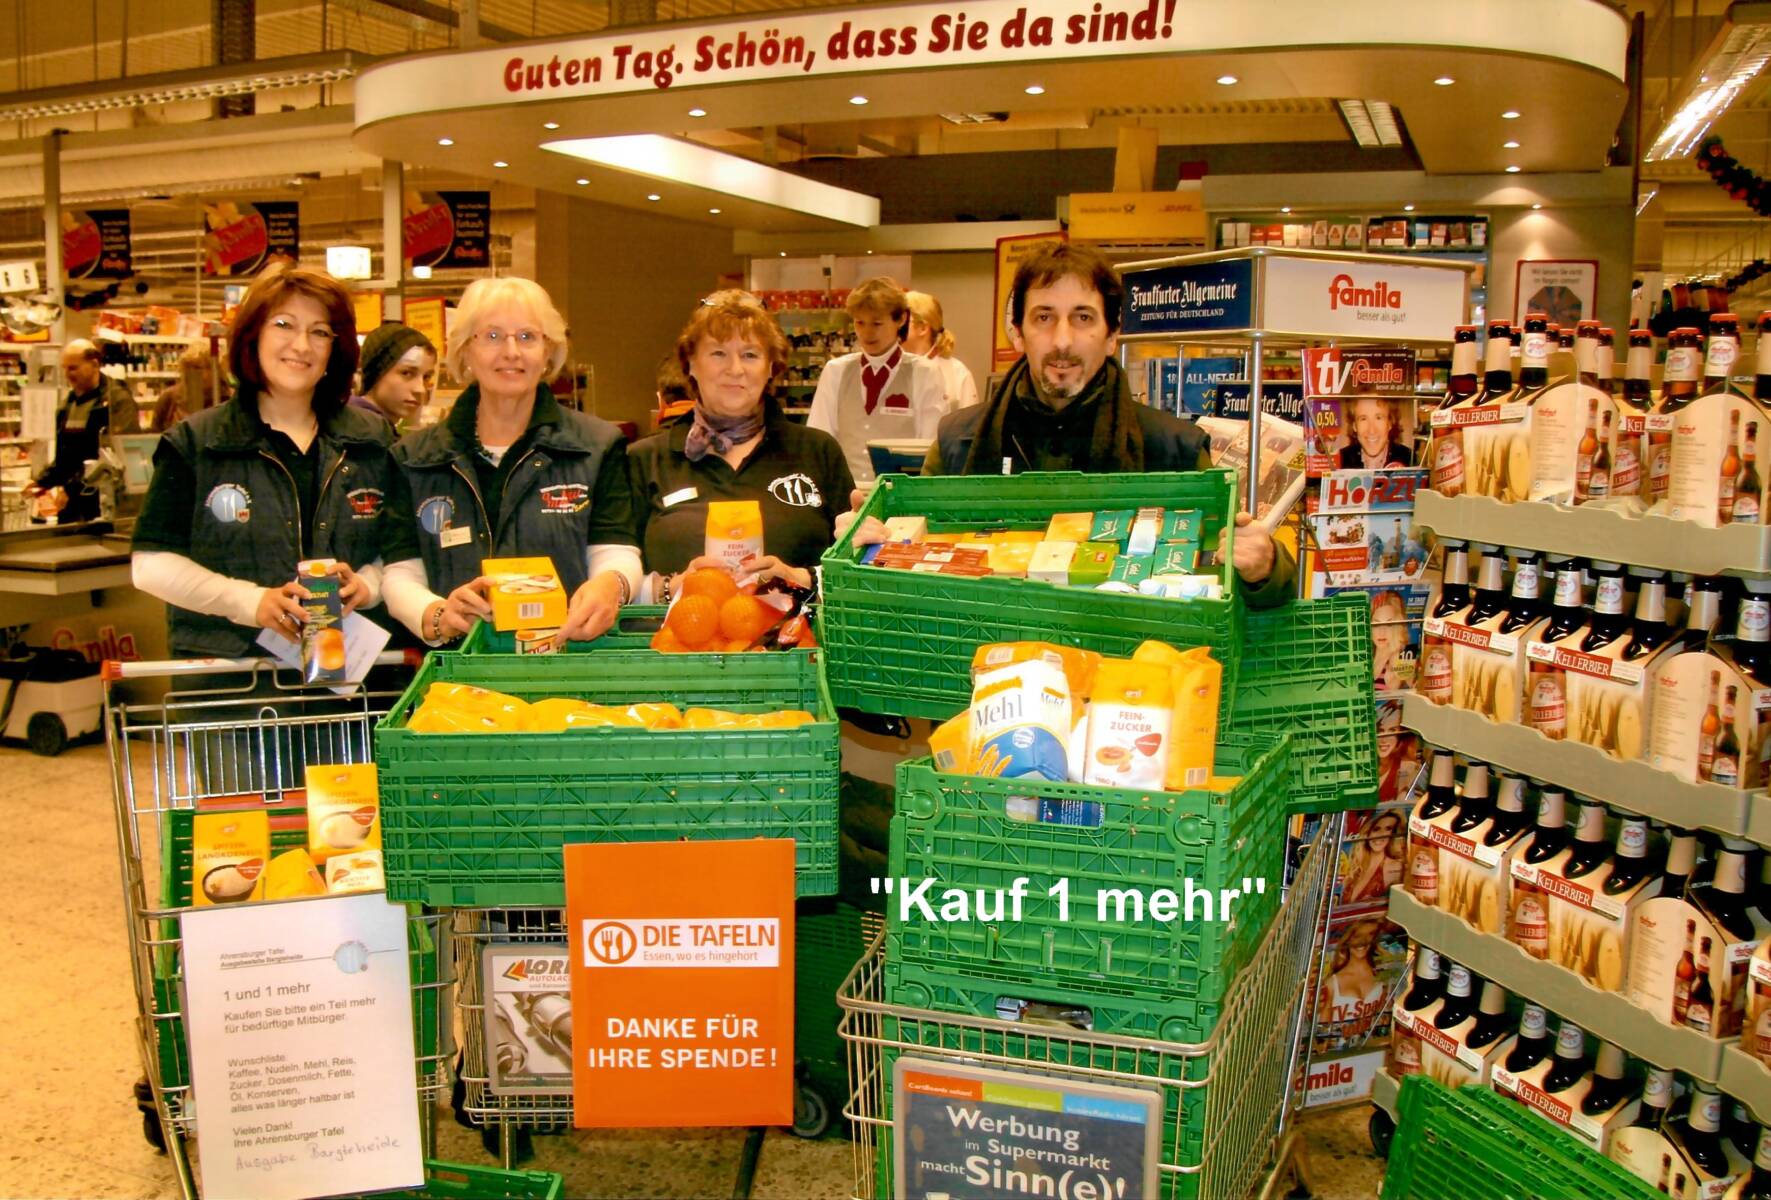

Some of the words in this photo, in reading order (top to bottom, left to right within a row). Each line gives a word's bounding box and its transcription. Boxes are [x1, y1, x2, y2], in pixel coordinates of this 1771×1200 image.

[503, 54, 601, 92] Guten
[613, 44, 683, 89] Tag.
[693, 31, 816, 73] Schön,
[826, 21, 918, 61] dass
[927, 12, 988, 53] Sie
[1000, 7, 1054, 48] da
[1065, 0, 1177, 44] sind!
[1131, 284, 1181, 312] Frankfurter
[1180, 278, 1237, 308] Allgemeine
[1329, 274, 1401, 310] famila
[1141, 311, 1164, 321] ZEITUNG
[1166, 309, 1178, 320] FÜR
[1179, 308, 1225, 319] DEUTSCHLAND
[1316, 352, 1353, 395] tv
[1351, 358, 1403, 388] famila
[1452, 410, 1499, 424] KELLERBIER
[1443, 624, 1488, 648] KELLERBIER
[1555, 649, 1610, 676] KELLERBIER
[975, 694, 1023, 730] Mehl
[1119, 711, 1145, 721] FEIN-
[1110, 721, 1152, 733] ZUCKER
[1429, 827, 1474, 857] KELLERBIER
[1538, 872, 1591, 906] KELLERBIER
[642, 924, 681, 947] DIE
[688, 924, 776, 947] TAFELN
[642, 950, 676, 963] Essen,
[677, 952, 693, 962] wo
[694, 952, 706, 962] es
[708, 950, 759, 964] hingehört
[224, 990, 230, 1001] 1
[235, 987, 260, 1000] und
[265, 986, 272, 997] 1
[277, 982, 311, 995] mehr
[224, 1009, 262, 1021] Kaufen
[264, 1007, 282, 1017] Sie
[284, 1005, 307, 1015] bitte
[309, 1002, 326, 1012] ein
[328, 1000, 347, 1010] Teil
[349, 997, 376, 1007] mehr
[225, 1025, 240, 1034] für
[242, 1018, 294, 1032] bedürftige
[297, 1013, 345, 1025] Mitbürger
[607, 1017, 697, 1038] DANKE
[705, 1013, 759, 1038] FÜR
[1413, 1020, 1456, 1057] KELLERBIER
[589, 1048, 651, 1068] IHRE
[1295, 1063, 1353, 1092] amila
[231, 1103, 253, 1113] alles
[256, 1101, 276, 1111] was
[277, 1097, 308, 1110] länger
[309, 1092, 341, 1105] haltbar
[343, 1090, 355, 1100] ist
[1516, 1083, 1569, 1123] KELLERBIER
[233, 1125, 263, 1137] Vielen
[265, 1121, 293, 1132] Dank!
[233, 1137, 253, 1148] Ihre
[255, 1129, 318, 1146] Ahrensburger
[320, 1126, 345, 1137] Tafel
[946, 1105, 1080, 1151] Werbung
[236, 1152, 297, 1173] Ausgabe
[965, 1140, 979, 1151] im
[988, 1138, 1111, 1171] Supermarkt
[921, 1160, 965, 1176] macht
[965, 1155, 1126, 1200] Sinn(e)!
